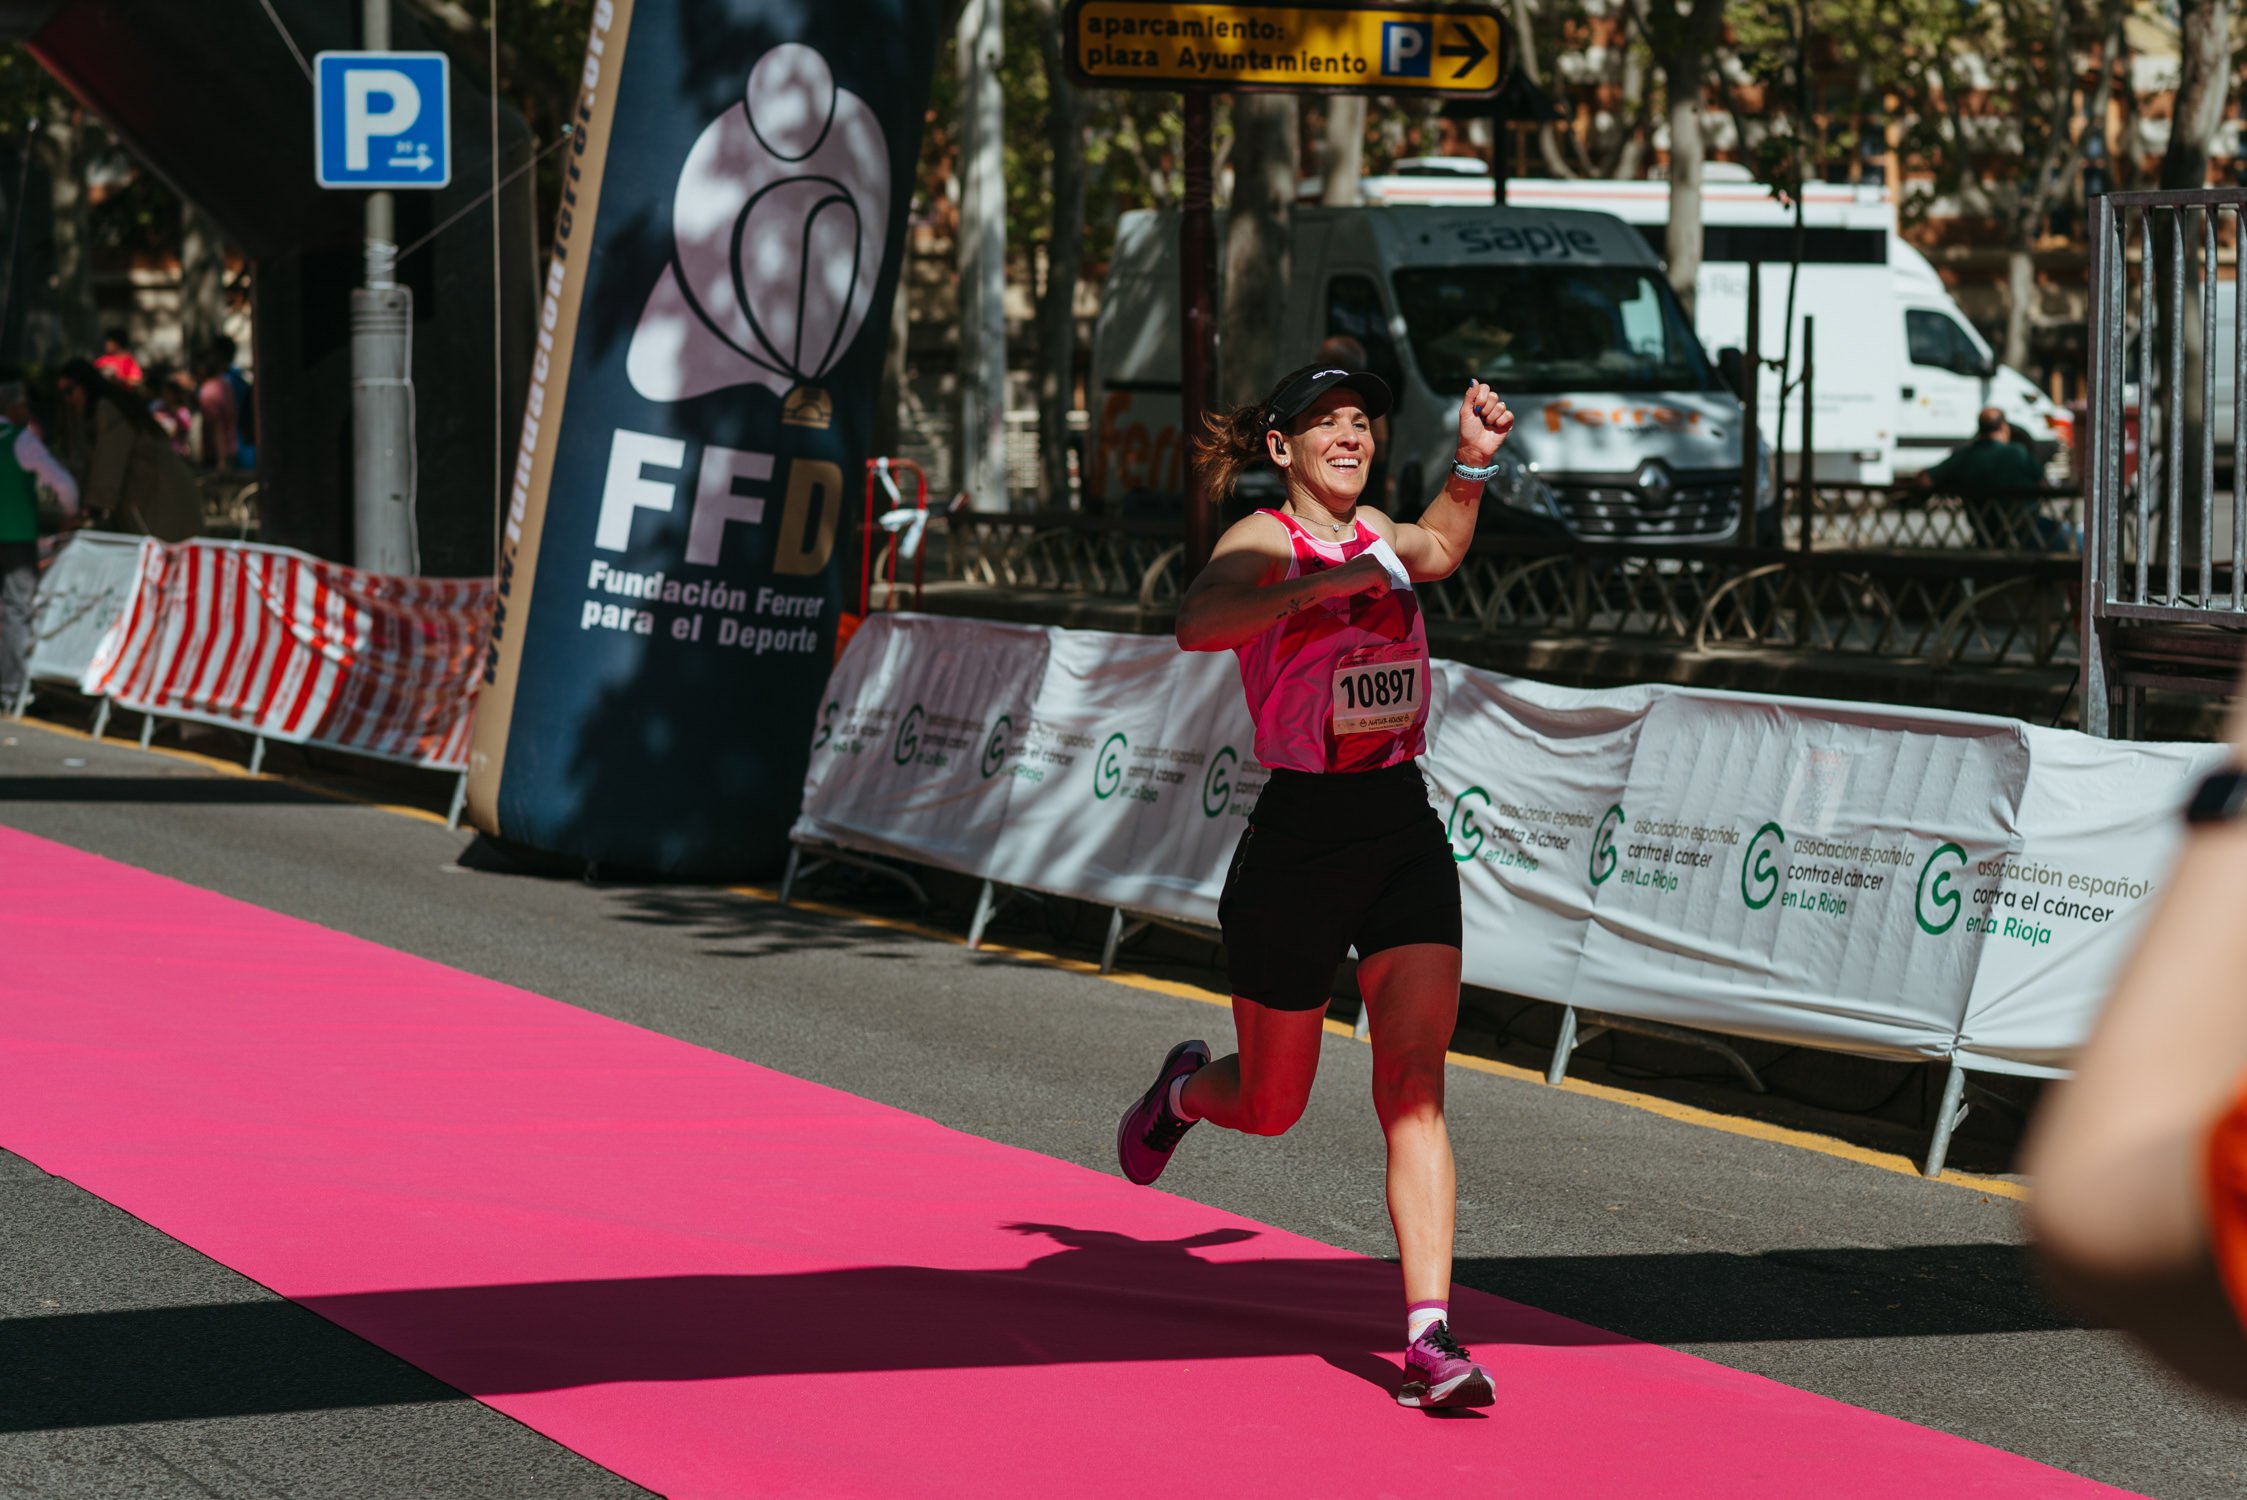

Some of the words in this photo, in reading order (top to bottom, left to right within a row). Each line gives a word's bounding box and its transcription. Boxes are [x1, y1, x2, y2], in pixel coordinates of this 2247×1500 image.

[1087, 15, 1285, 41] aparcamiento:
[1087, 44, 1159, 70] plaza
[1178, 46, 1368, 75] Ayuntamiento
[1388, 25, 1424, 73] P
[344, 68, 422, 171] P
[594, 428, 844, 576] FFD
[587, 559, 747, 612] Fundación
[755, 586, 825, 618] Ferrer
[580, 599, 654, 634] para
[671, 614, 703, 641] el
[718, 617, 818, 655] Deporte
[1340, 668, 1415, 709] 10897
[1500, 803, 1552, 822] asociación
[1553, 808, 1594, 829] española
[1634, 817, 1689, 839] asociación
[1690, 823, 1740, 846] española
[1526, 829, 1538, 846] el
[1793, 837, 1859, 861] asociación
[1860, 845, 1915, 868] española
[1484, 847, 1498, 862] en
[1500, 846, 1514, 865] La
[1516, 850, 1540, 873] Rioja
[1627, 840, 1662, 861] contra
[1663, 842, 1673, 863] el
[1675, 845, 1713, 868] cáncer
[1620, 869, 1634, 884] en
[1636, 867, 1650, 886] La
[1652, 871, 1679, 894] Rioja
[1787, 862, 1831, 884] contra
[1831, 868, 1843, 887] el
[1844, 869, 1884, 891] cáncer
[1977, 859, 2063, 888] asociación
[1781, 890, 1797, 908] en
[1800, 888, 1816, 911] La
[1818, 892, 1847, 919] Rioja
[2021, 891, 2040, 912] el
[2043, 897, 2115, 923] cáncer
[2003, 916, 2052, 948] Rioja
